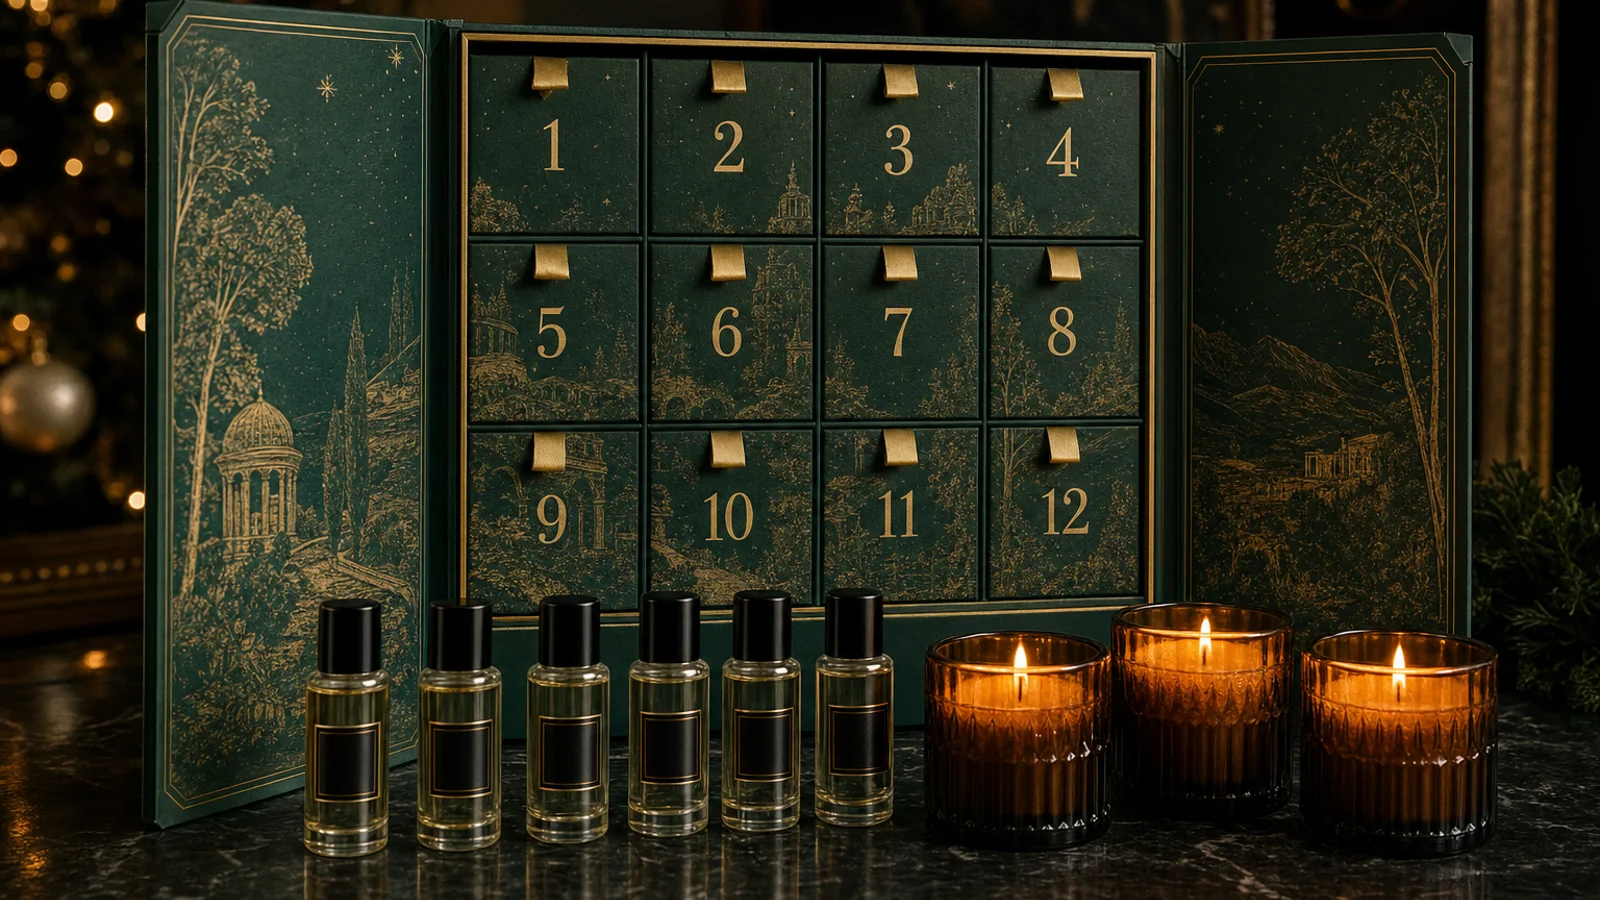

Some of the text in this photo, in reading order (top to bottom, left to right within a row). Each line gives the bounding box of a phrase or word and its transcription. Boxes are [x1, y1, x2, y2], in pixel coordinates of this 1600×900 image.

[543, 119, 565, 171] 1
[713, 121, 745, 173] 2
[884, 124, 914, 176] 3
[1045, 126, 1079, 177] 4
[537, 306, 567, 359] 5
[711, 306, 742, 357] 6
[884, 308, 913, 357] 7
[1047, 306, 1077, 357] 8
[536, 494, 567, 545] 9
[703, 492, 754, 541] 10
[878, 490, 919, 538] 11
[1042, 488, 1090, 535] 12
